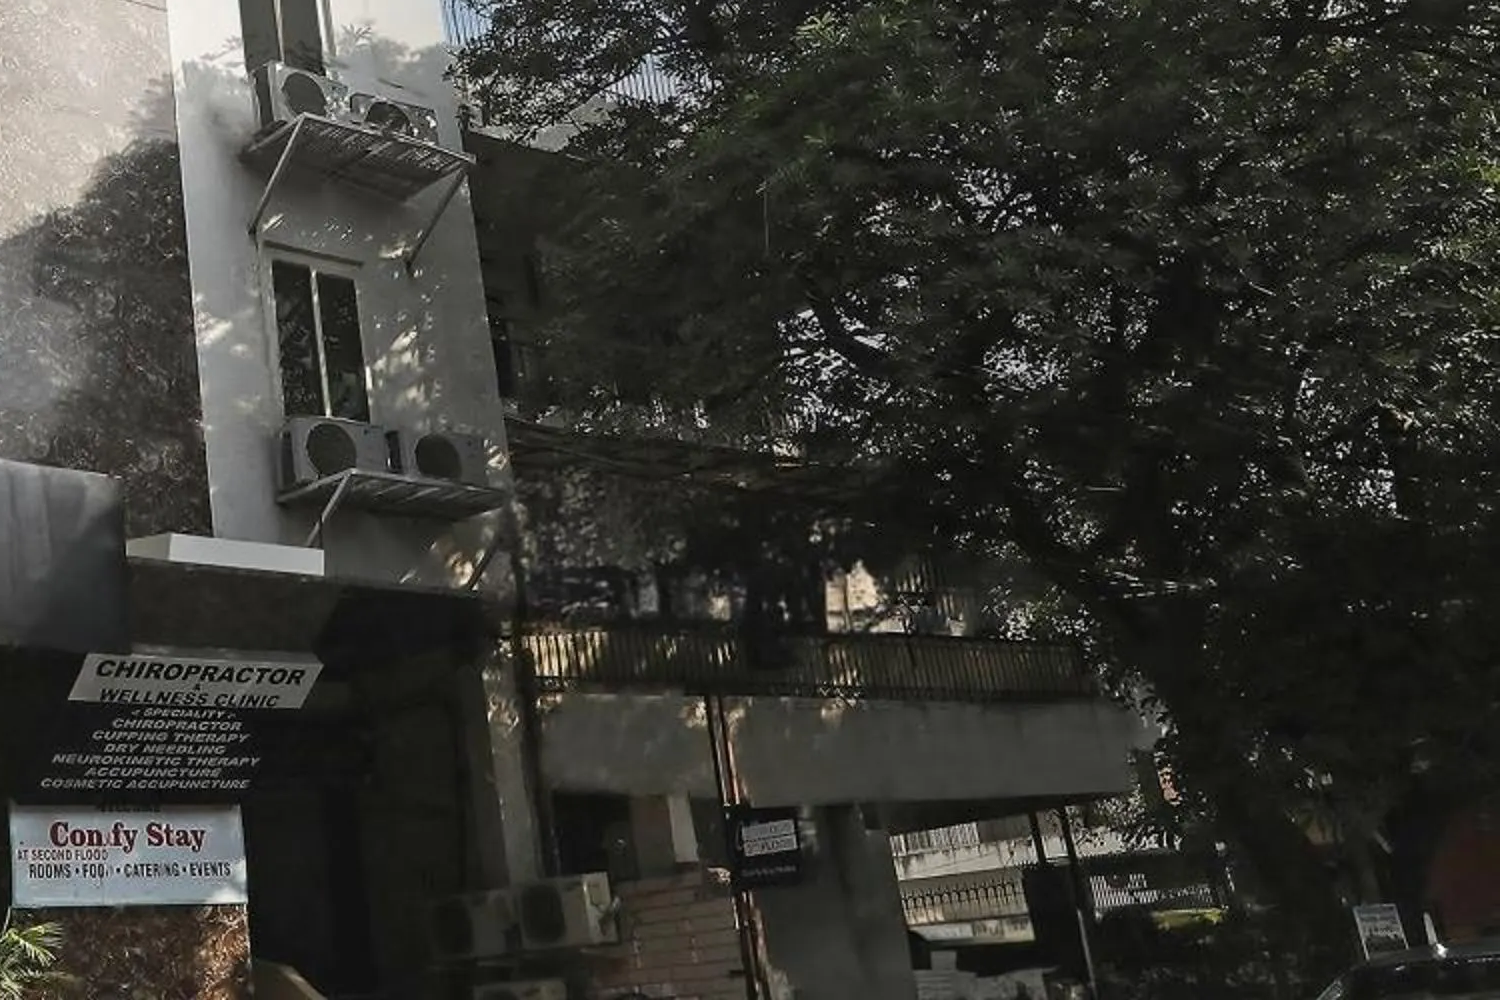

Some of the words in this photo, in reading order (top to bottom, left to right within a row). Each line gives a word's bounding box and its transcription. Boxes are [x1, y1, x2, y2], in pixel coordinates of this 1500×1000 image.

[96, 660, 306, 686] CHIROPRACTOR
[100, 689, 209, 706] WELLNESS
[214, 693, 280, 708] CLINIC
[112, 717, 243, 732] CHIROPRACTOR
[91, 730, 169, 742] CUPPING
[173, 732, 251, 743] THERAPY
[103, 743, 139, 753] DRY
[142, 744, 227, 755] NEEDLING
[51, 754, 182, 766] NEUROKINETIC
[187, 757, 261, 768] THERAPY
[40, 778, 124, 789] COSMETIC
[145, 821, 207, 853] Stay
[31, 849, 73, 861] SECOND
[29, 863, 72, 878] ROOMS
[124, 862, 181, 878] CATERNG
[189, 862, 232, 877] EVENTS
